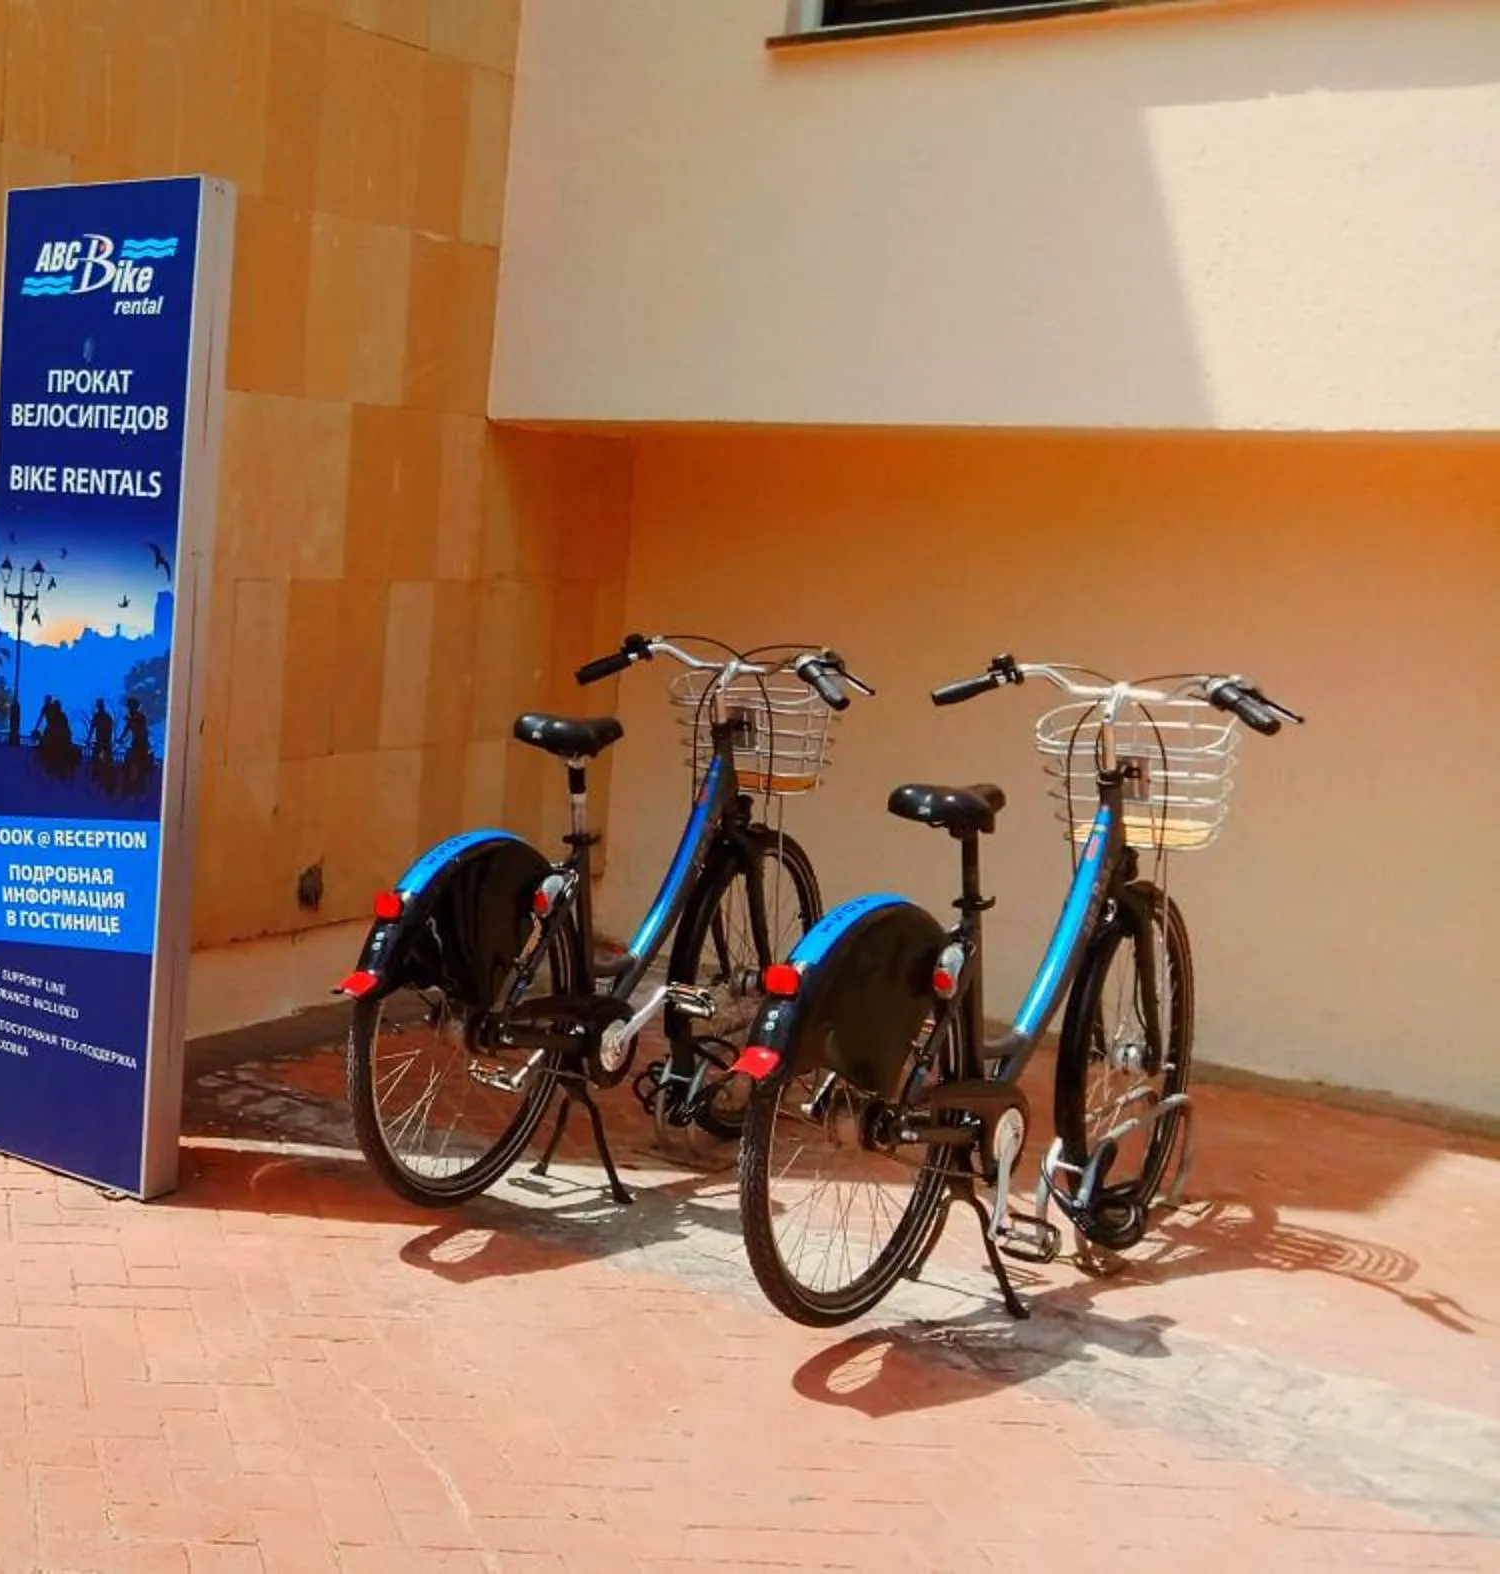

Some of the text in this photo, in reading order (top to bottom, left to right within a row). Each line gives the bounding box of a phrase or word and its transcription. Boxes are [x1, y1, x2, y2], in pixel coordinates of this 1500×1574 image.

[36, 233, 155, 295] ABC Bike
[113, 296, 163, 315] rental
[47, 369, 132, 394] ПРОКАТ
[11, 403, 169, 435] ВЕЛОСИПЕДОВ
[9, 465, 162, 498] BIKE RENTALS
[37, 833, 51, 848] @
[54, 829, 147, 849] RECEPTION
[9, 864, 113, 885] ПОДРОБНАЯ
[2, 886, 125, 912] ИНФОРМАЦИЯ
[6, 909, 121, 936] В ГОСТИНИЦЕ
[2, 969, 43, 989] SUPPORT
[45, 980, 66, 996] LINE
[33, 996, 79, 1019] INCLUDED
